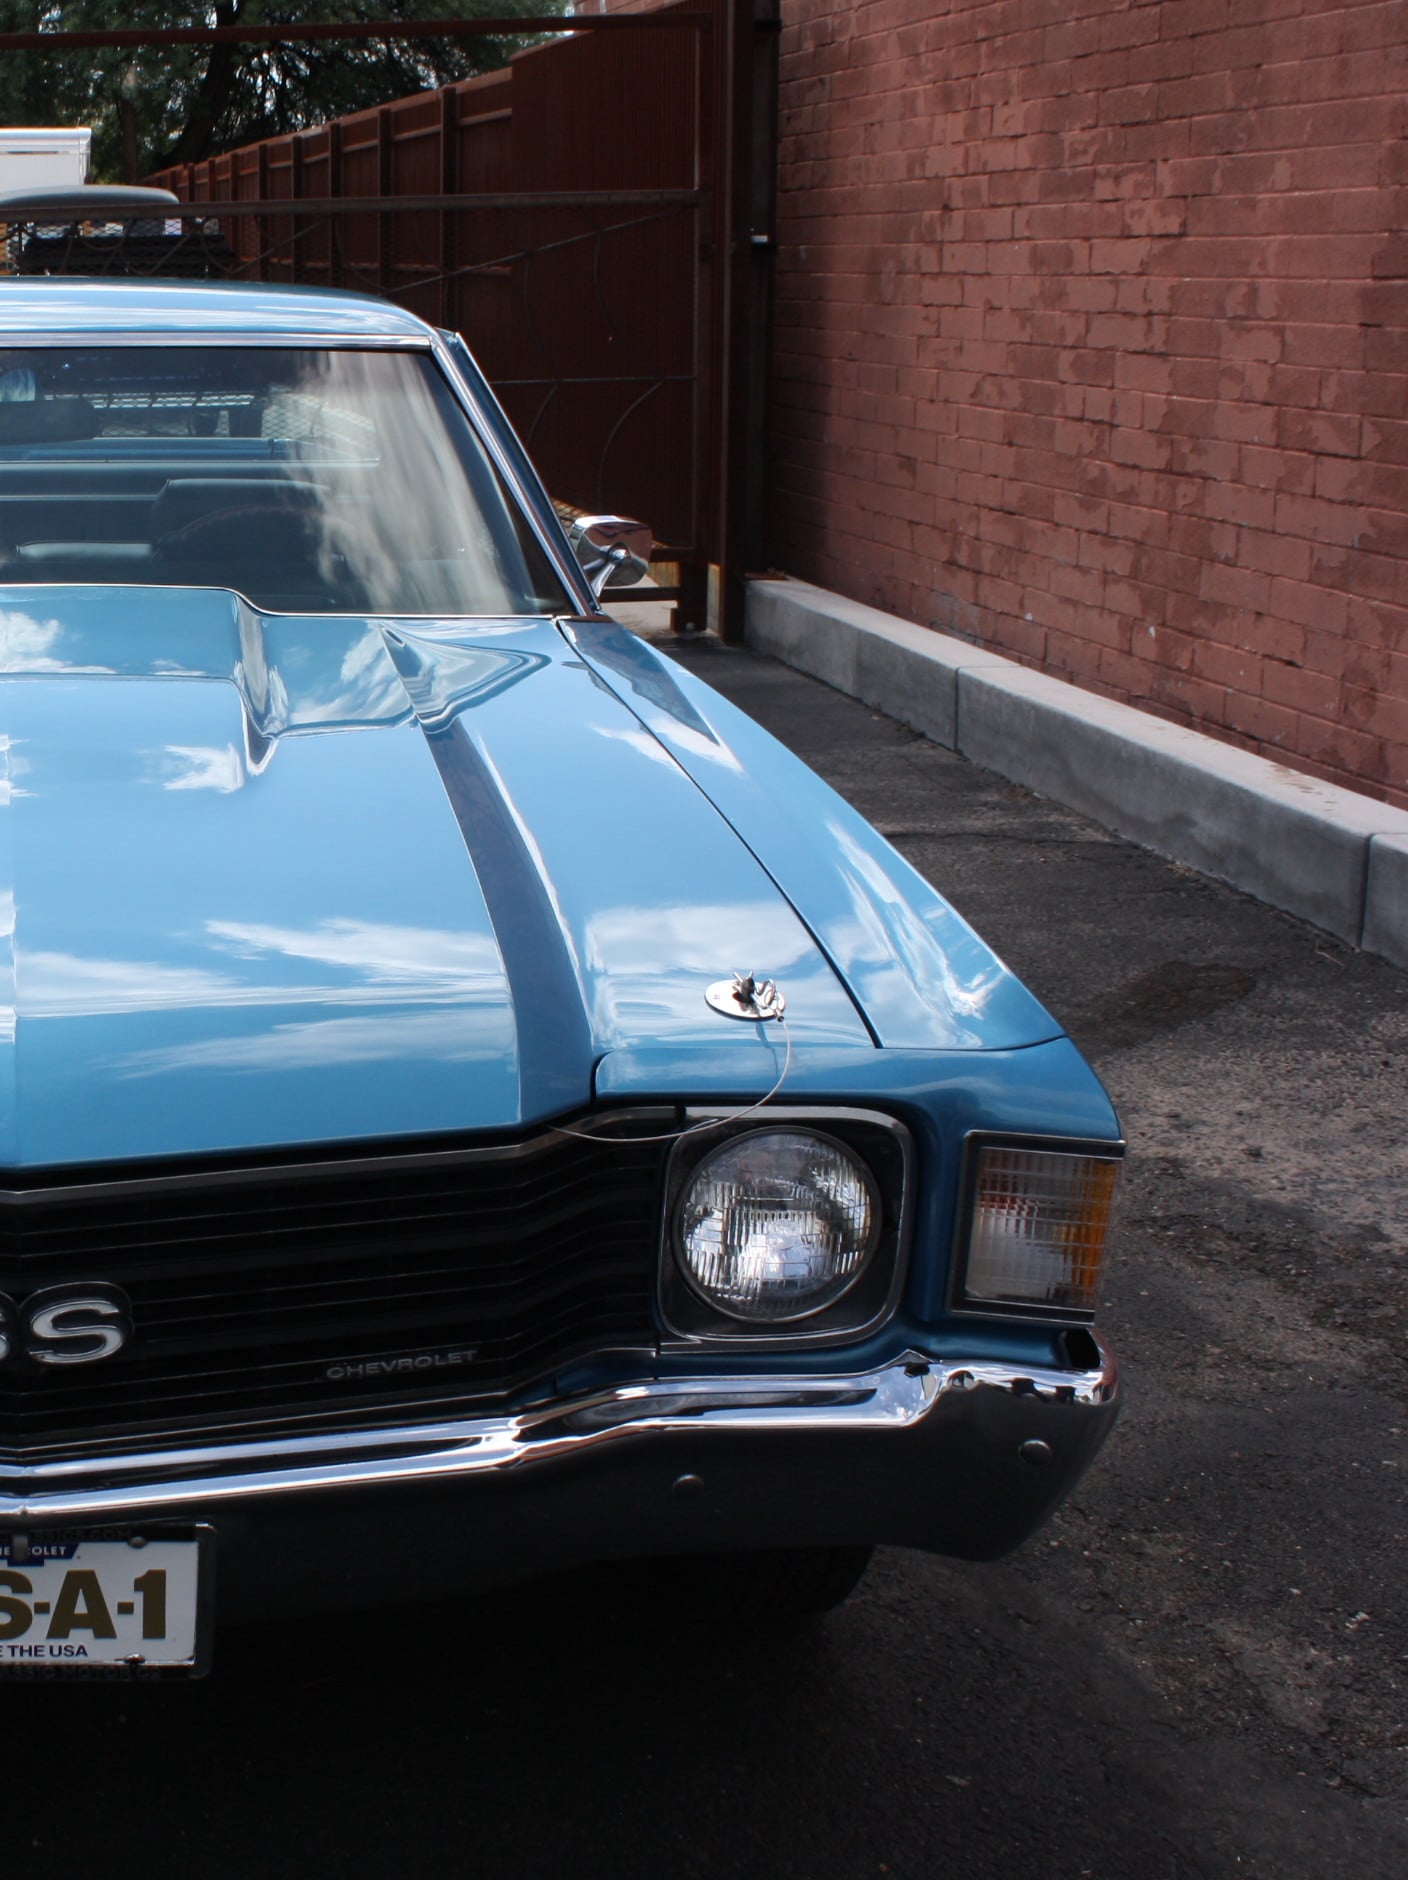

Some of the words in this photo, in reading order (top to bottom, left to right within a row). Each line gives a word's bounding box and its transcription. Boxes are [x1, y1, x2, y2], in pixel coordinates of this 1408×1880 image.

[326, 1350, 478, 1379] CHEVROLET
[7, 1645, 44, 1657] THE
[49, 1645, 88, 1657] USA
